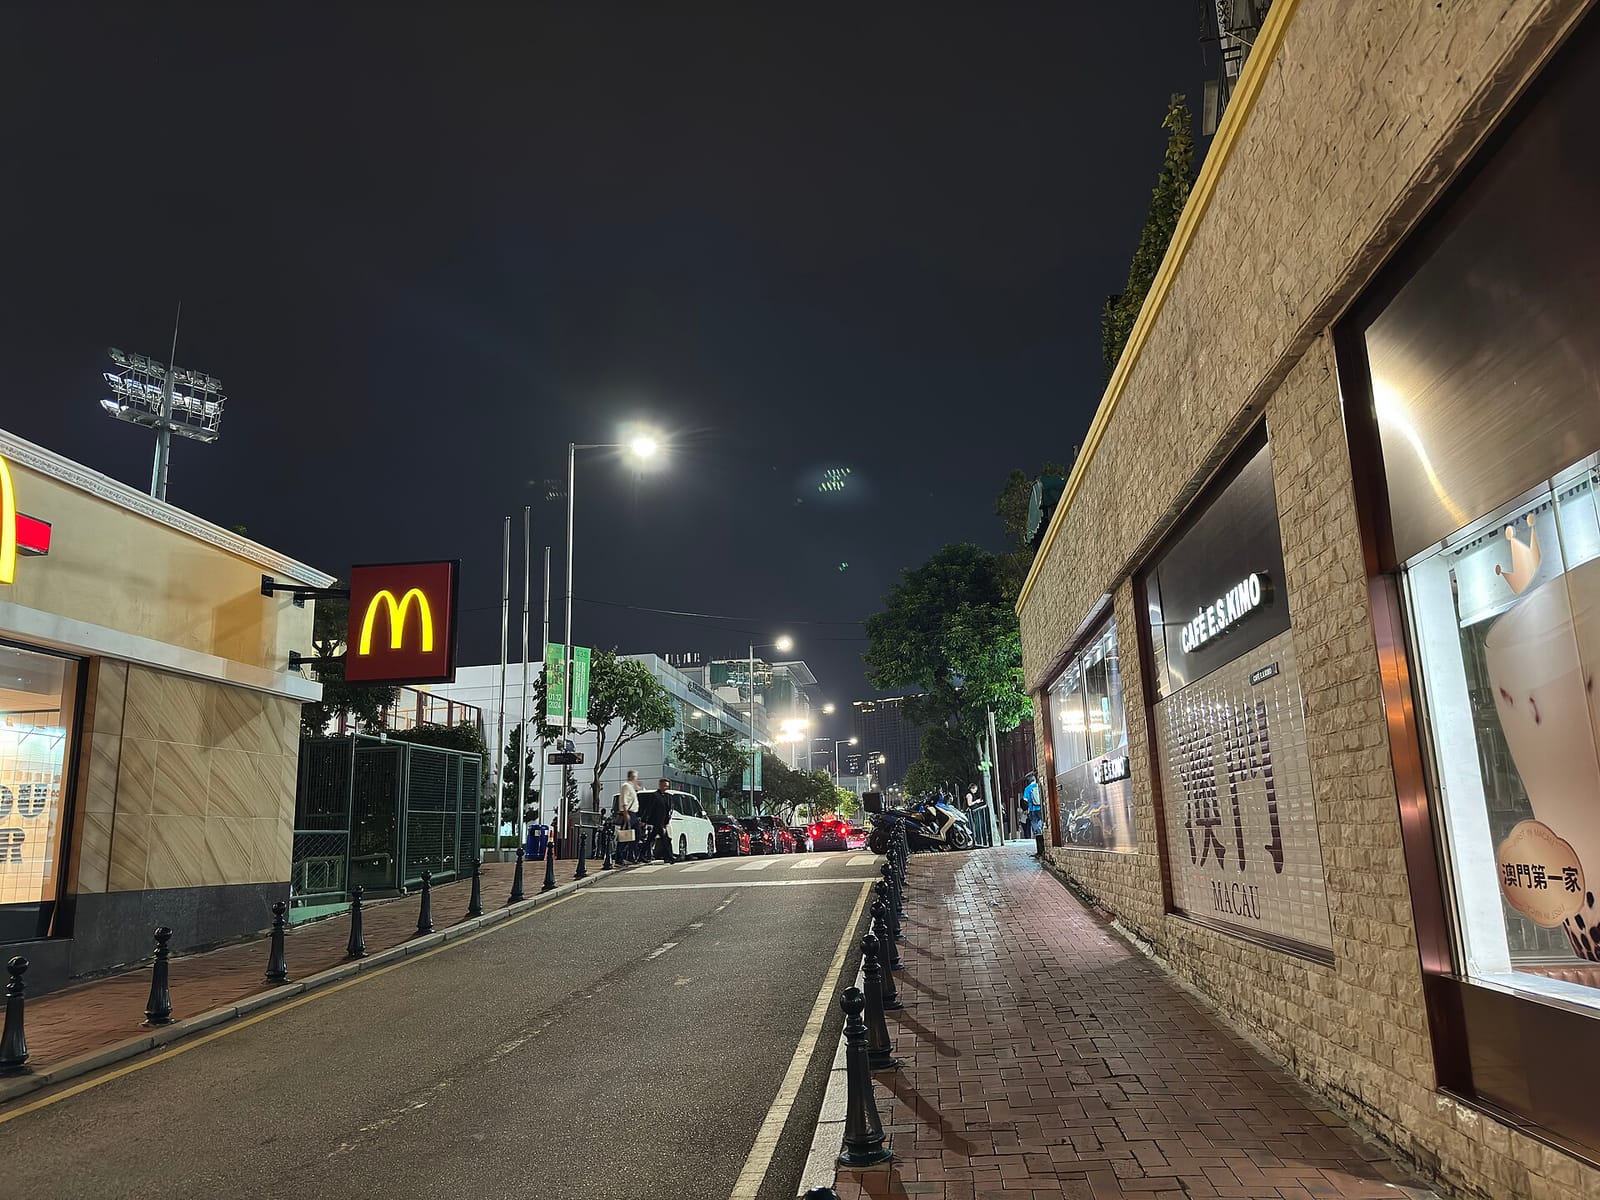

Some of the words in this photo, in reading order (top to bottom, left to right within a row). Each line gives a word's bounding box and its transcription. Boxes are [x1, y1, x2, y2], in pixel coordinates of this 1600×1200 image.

[1182, 606, 1208, 654] CAFÉ
[1206, 572, 1261, 637] E.S.KIMO
[1177, 699, 1284, 874] 澳門
[1211, 879, 1261, 920] MACAU
[1501, 862, 1581, 893] 澳門第一家
